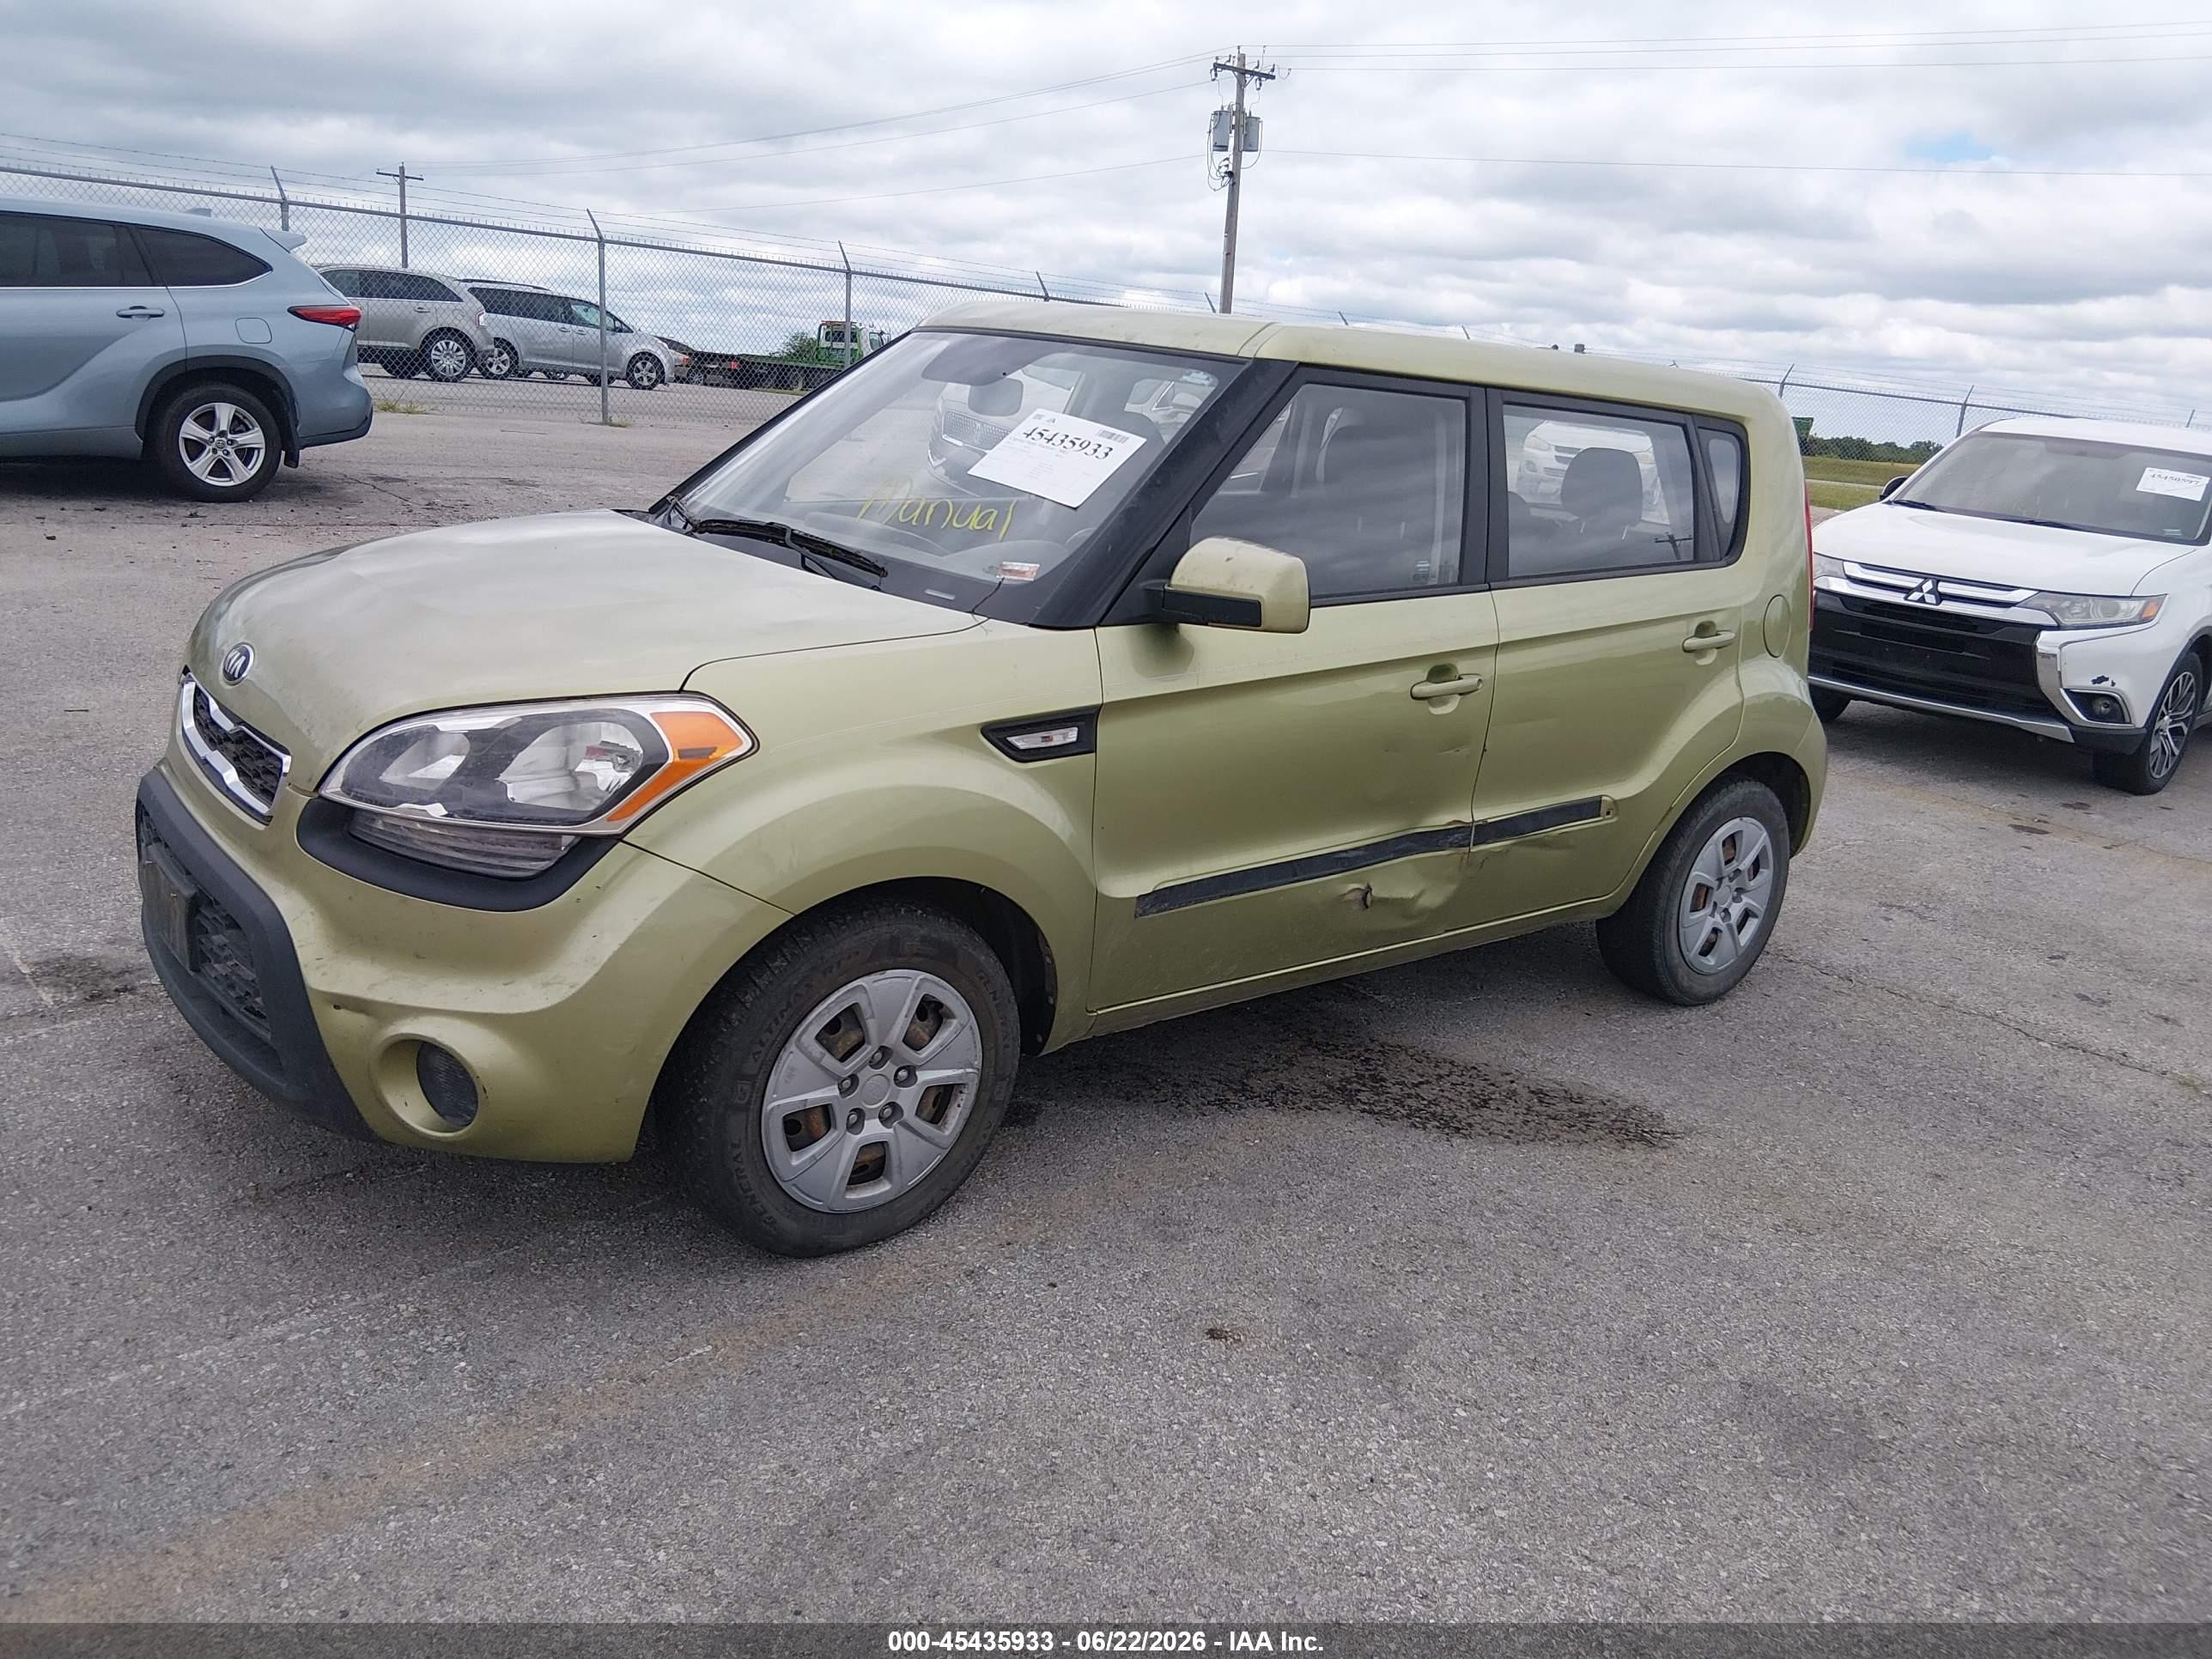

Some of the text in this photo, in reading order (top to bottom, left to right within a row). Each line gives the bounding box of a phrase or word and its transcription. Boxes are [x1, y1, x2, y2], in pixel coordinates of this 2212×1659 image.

[1023, 426, 1114, 460] 45435933
[856, 476, 1018, 542] Manual
[225, 649, 246, 678] KIA
[730, 1139, 777, 1226] GENERAL
